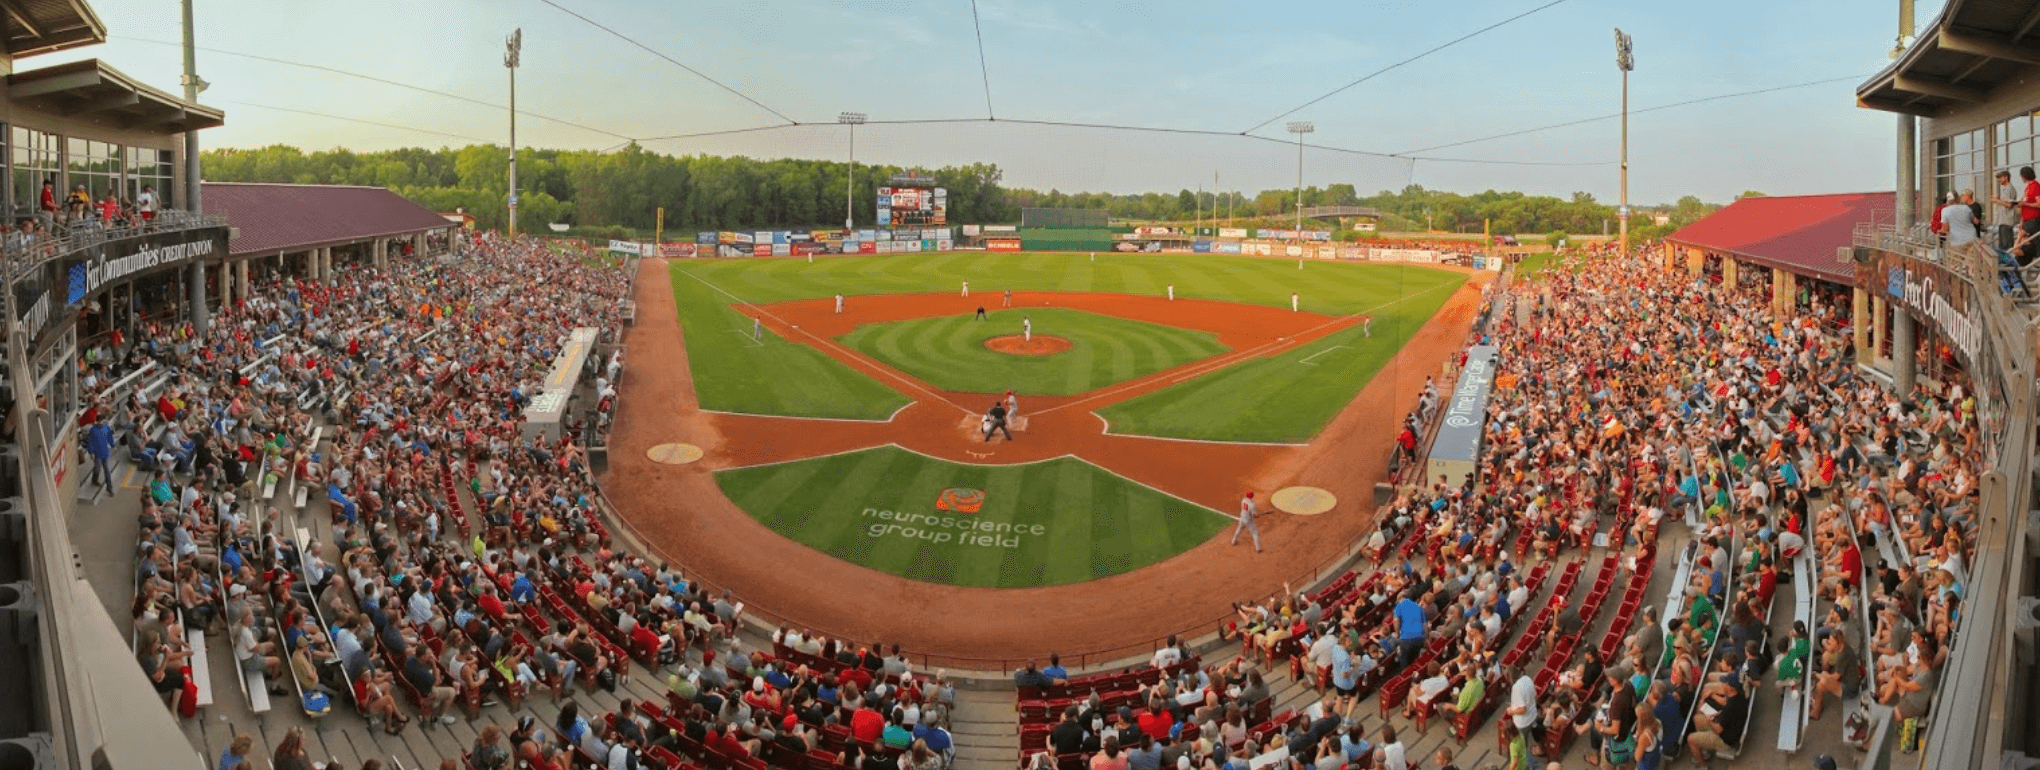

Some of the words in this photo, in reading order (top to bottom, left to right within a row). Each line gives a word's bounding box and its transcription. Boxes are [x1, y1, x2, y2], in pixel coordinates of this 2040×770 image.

[86, 259, 100, 294] Fox
[100, 243, 159, 284] Communities
[160, 243, 187, 264] CREDIT
[187, 239, 213, 258] UNION
[1904, 269, 1922, 311] Fox
[862, 507, 1045, 535] neuroscience
[867, 523, 952, 544] group
[959, 531, 1020, 548] field
